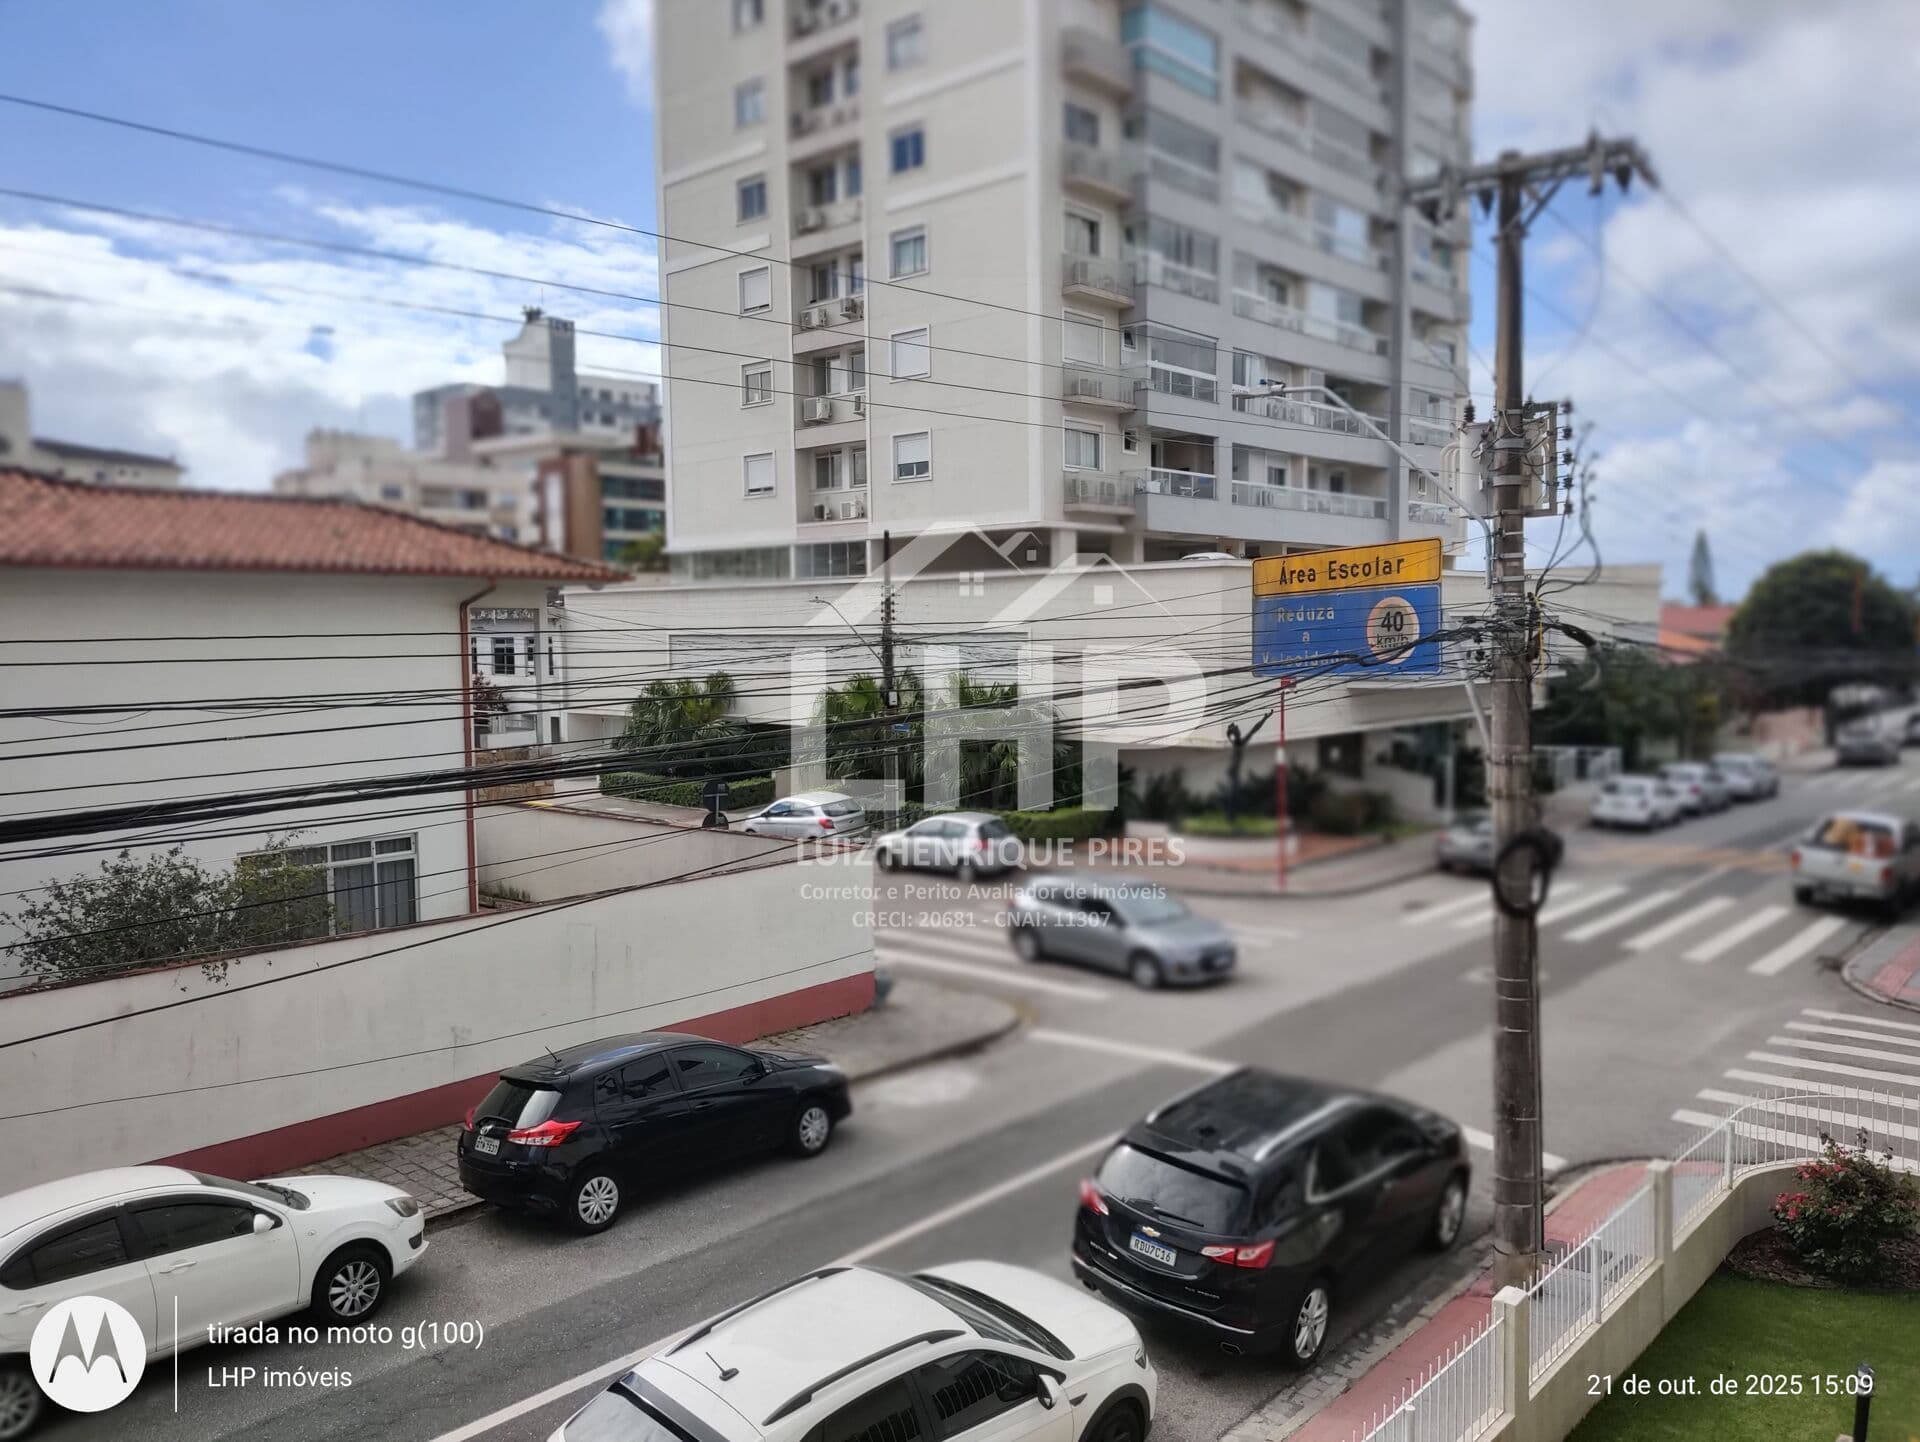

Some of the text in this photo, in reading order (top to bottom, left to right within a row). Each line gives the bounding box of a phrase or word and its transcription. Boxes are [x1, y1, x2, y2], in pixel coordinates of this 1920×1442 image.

[1279, 557, 1405, 585] Área Escolar
[1277, 606, 1334, 623] Reduza
[1380, 611, 1404, 632] 40
[1302, 632, 1310, 643] a
[1376, 633, 1408, 648] km/h
